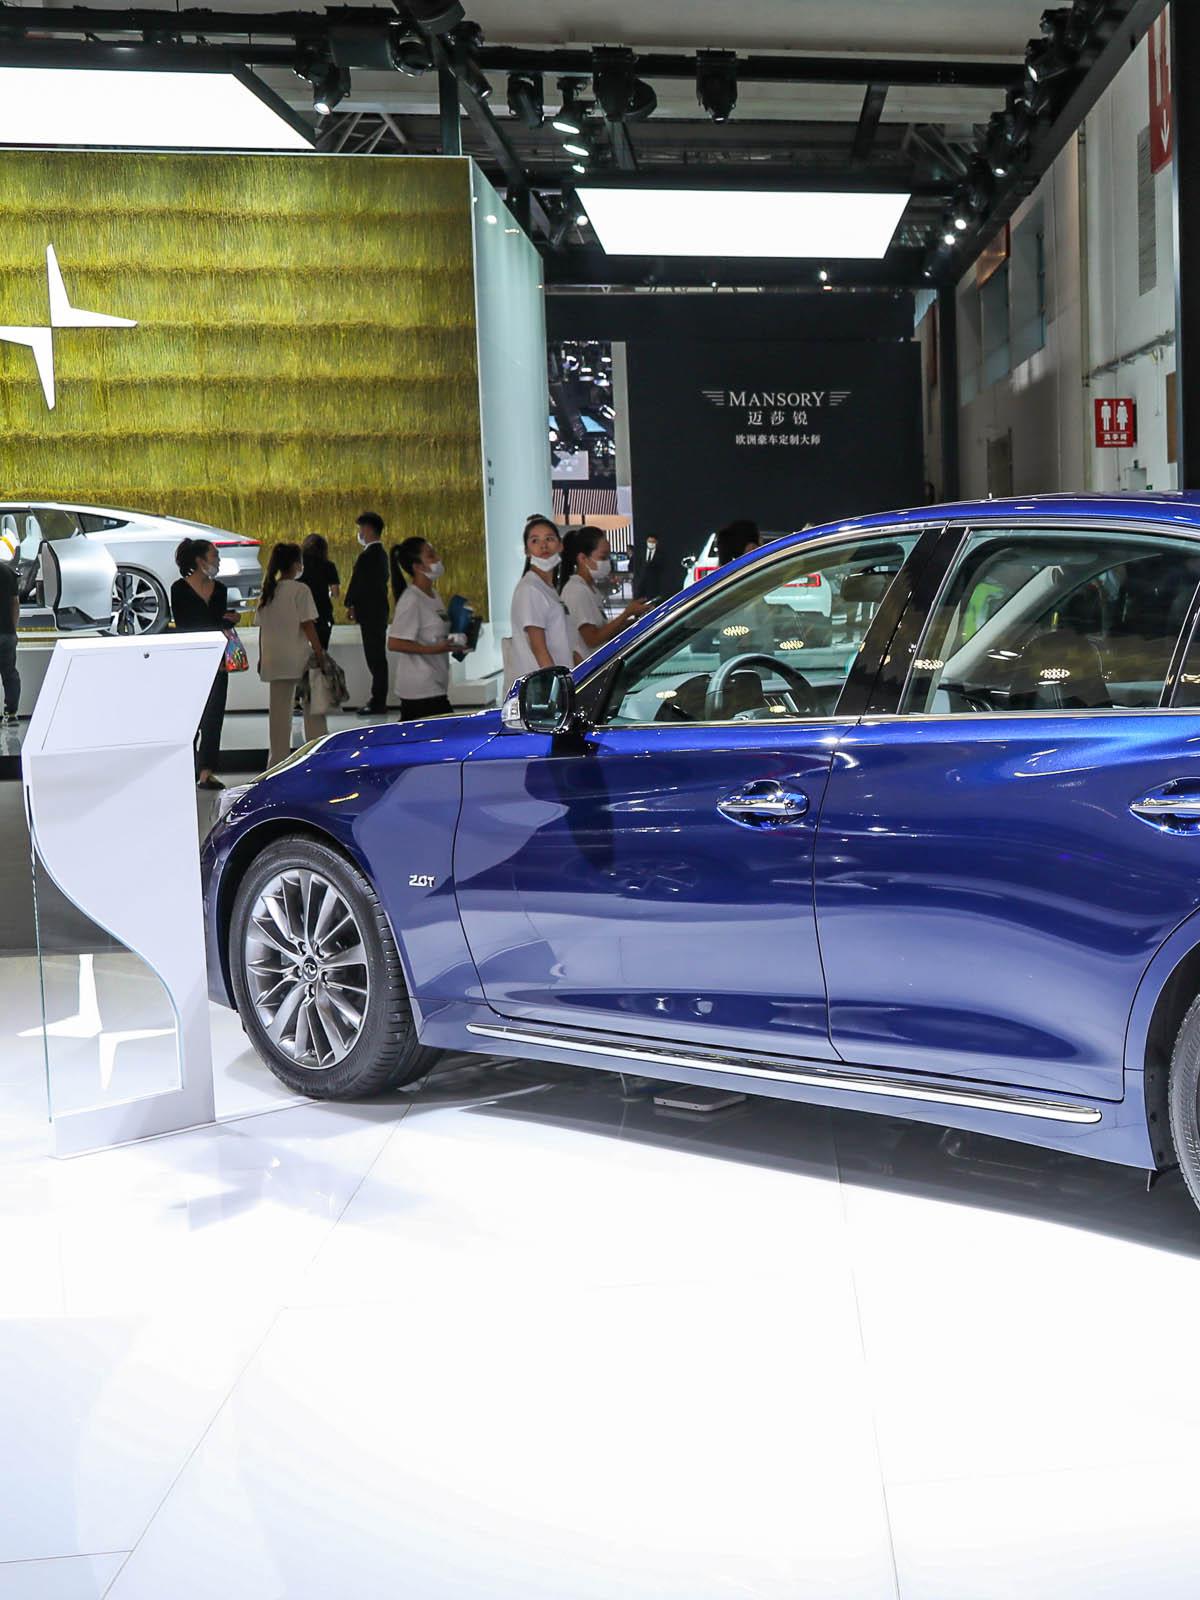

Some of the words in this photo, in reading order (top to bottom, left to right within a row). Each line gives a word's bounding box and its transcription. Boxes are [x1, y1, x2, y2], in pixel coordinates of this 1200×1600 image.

[729, 391, 824, 407] MANSORY
[747, 410, 808, 426] 迈莎锐
[735, 434, 821, 446] 欧洲豪车定制大师
